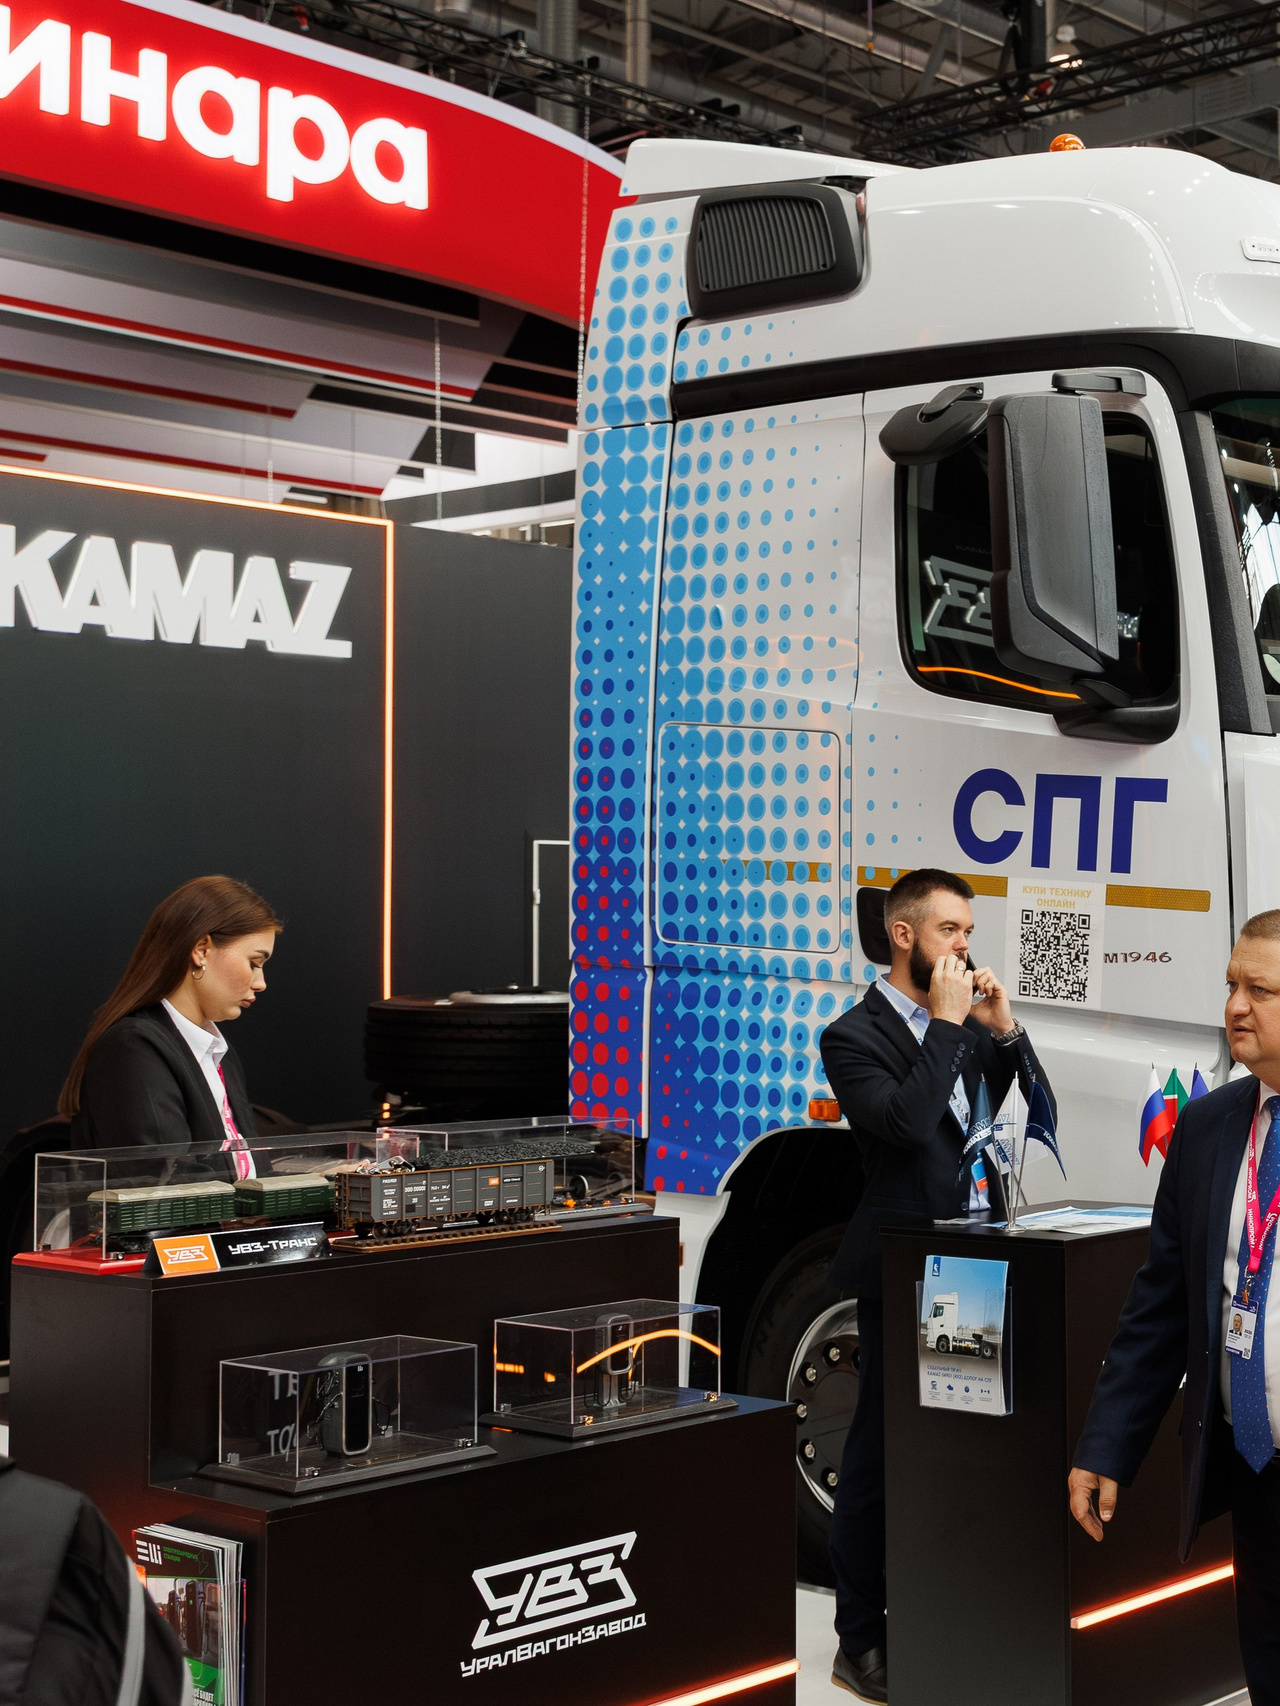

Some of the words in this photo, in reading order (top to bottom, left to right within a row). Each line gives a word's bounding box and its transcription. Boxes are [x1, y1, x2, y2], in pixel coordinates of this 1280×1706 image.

[0, 526, 352, 660] KAMAZ
[952, 767, 1169, 875] СПГ
[1022, 885, 1046, 895] КУПИ
[1049, 887, 1092, 898] ТЕХНИКУ
[1036, 898, 1076, 909] ОНЛАЙН
[163, 1245, 209, 1265] УВЗ
[471, 1530, 637, 1650] УВЗ
